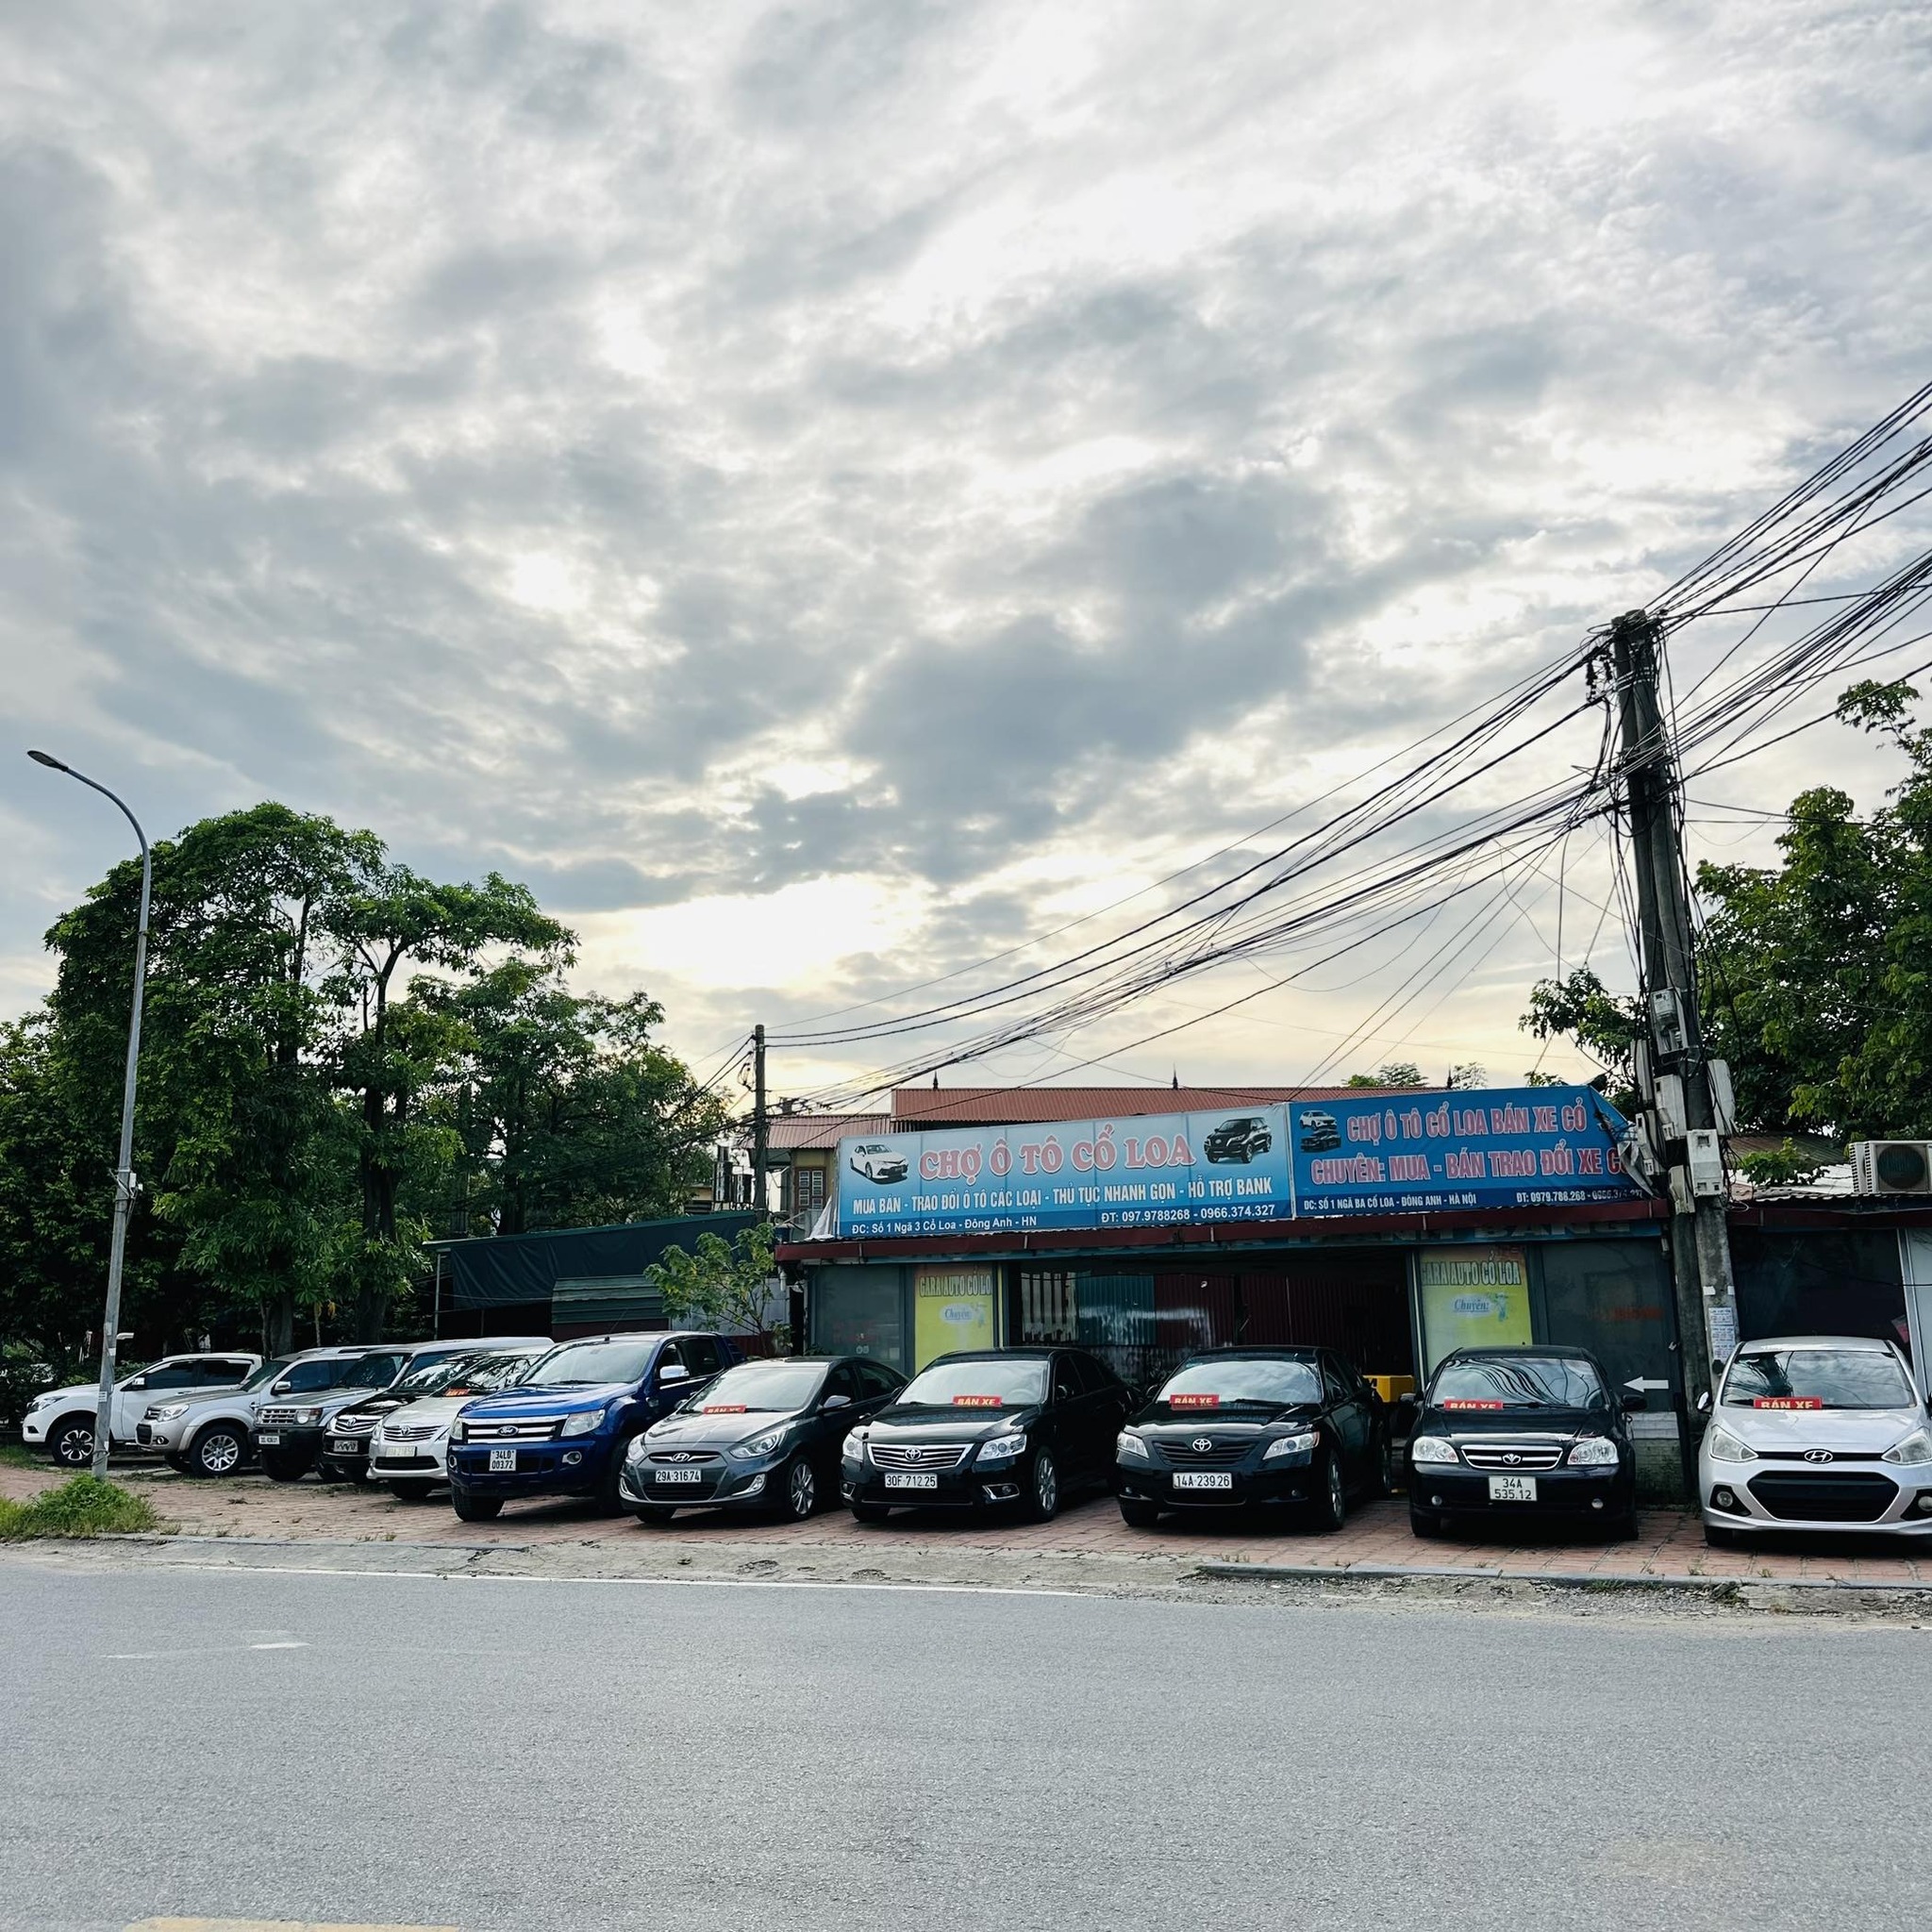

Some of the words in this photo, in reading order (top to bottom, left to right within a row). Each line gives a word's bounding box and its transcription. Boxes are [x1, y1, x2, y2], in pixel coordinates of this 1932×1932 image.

[1347, 1112, 1382, 1146] CHỢ
[1384, 1108, 1398, 1140] Ô
[1400, 1108, 1423, 1139] TÔ
[1426, 1101, 1450, 1138] CỔ
[1454, 1107, 1488, 1136] LOA
[1491, 1103, 1529, 1135] BÁN
[1533, 1106, 1557, 1133] XE
[1561, 1096, 1587, 1132] CỎ
[920, 1142, 983, 1186] CHỢ
[990, 1137, 1012, 1175] Ô
[1021, 1135, 1063, 1174] TÔ
[1072, 1124, 1117, 1171] CỔ
[1124, 1134, 1196, 1169] LOA
[1310, 1153, 1386, 1185] CHUYÊN:
[1389, 1155, 1431, 1182] MUA
[1445, 1147, 1486, 1179] BÁN
[1488, 1149, 1537, 1177] TRAO
[1540, 1139, 1574, 1175] ĐỔI
[1577, 1148, 1603, 1175] XE
[853, 1197, 875, 1215] MUA
[879, 1193, 901, 1213] BÁN
[911, 1195, 938, 1212] TRAO
[941, 1188, 958, 1210] ĐỔI
[963, 1191, 971, 1208] Ô
[974, 1190, 988, 1208] TÔ
[991, 1188, 1013, 1208] CÁC
[1017, 1190, 1041, 1210] LOẠI
[1053, 1182, 1074, 1204] THỦ
[1078, 1187, 1101, 1207] TỤC
[1105, 1184, 1146, 1202] NHANH
[1150, 1183, 1175, 1204] GỌN
[1188, 1174, 1205, 1198] HỖ
[1208, 1177, 1233, 1200] TRỢ
[1237, 1176, 1273, 1195] BANK
[1318, 1196, 1329, 1209] SỐ
[1330, 1199, 1335, 1209] 1
[1337, 1197, 1354, 1209] NGÃ
[1355, 1198, 1366, 1208] BA
[1380, 1197, 1395, 1208] LOA
[1401, 1193, 1424, 1208] ĐÔNG
[1425, 1195, 1441, 1206] ANH
[1449, 1192, 1460, 1205] HÀ
[1462, 1191, 1477, 1206] NỘI
[1530, 1191, 1586, 1203] 0979.788.268
[1102, 1211, 1119, 1223] ĐT:
[1122, 1208, 1191, 1223] 097.9788268
[1200, 1204, 1275, 1219] 0966.374.327
[852, 1224, 869, 1234] ĐC:
[872, 1221, 884, 1233] Số
[887, 1223, 891, 1232] 1
[894, 1222, 912, 1234] Ngã
[915, 1222, 921, 1231] 3
[923, 1218, 936, 1230] Cổ
[939, 1220, 956, 1230] Loa
[964, 1218, 990, 1231] Đông
[992, 1217, 1012, 1227] Anh
[1022, 1216, 1037, 1226] HN
[1450, 1260, 1479, 1285] AUTO
[1498, 1260, 1522, 1285] LOA
[920, 1275, 941, 1297] GARA
[943, 1274, 965, 1296] AUTO
[958, 1397, 978, 1406] BÁN
[1760, 1400, 1790, 1409] BÁN
[1794, 1401, 1813, 1409] XE
[1503, 1478, 1523, 1488] 34A
[1494, 1489, 1532, 1500] 535.12
